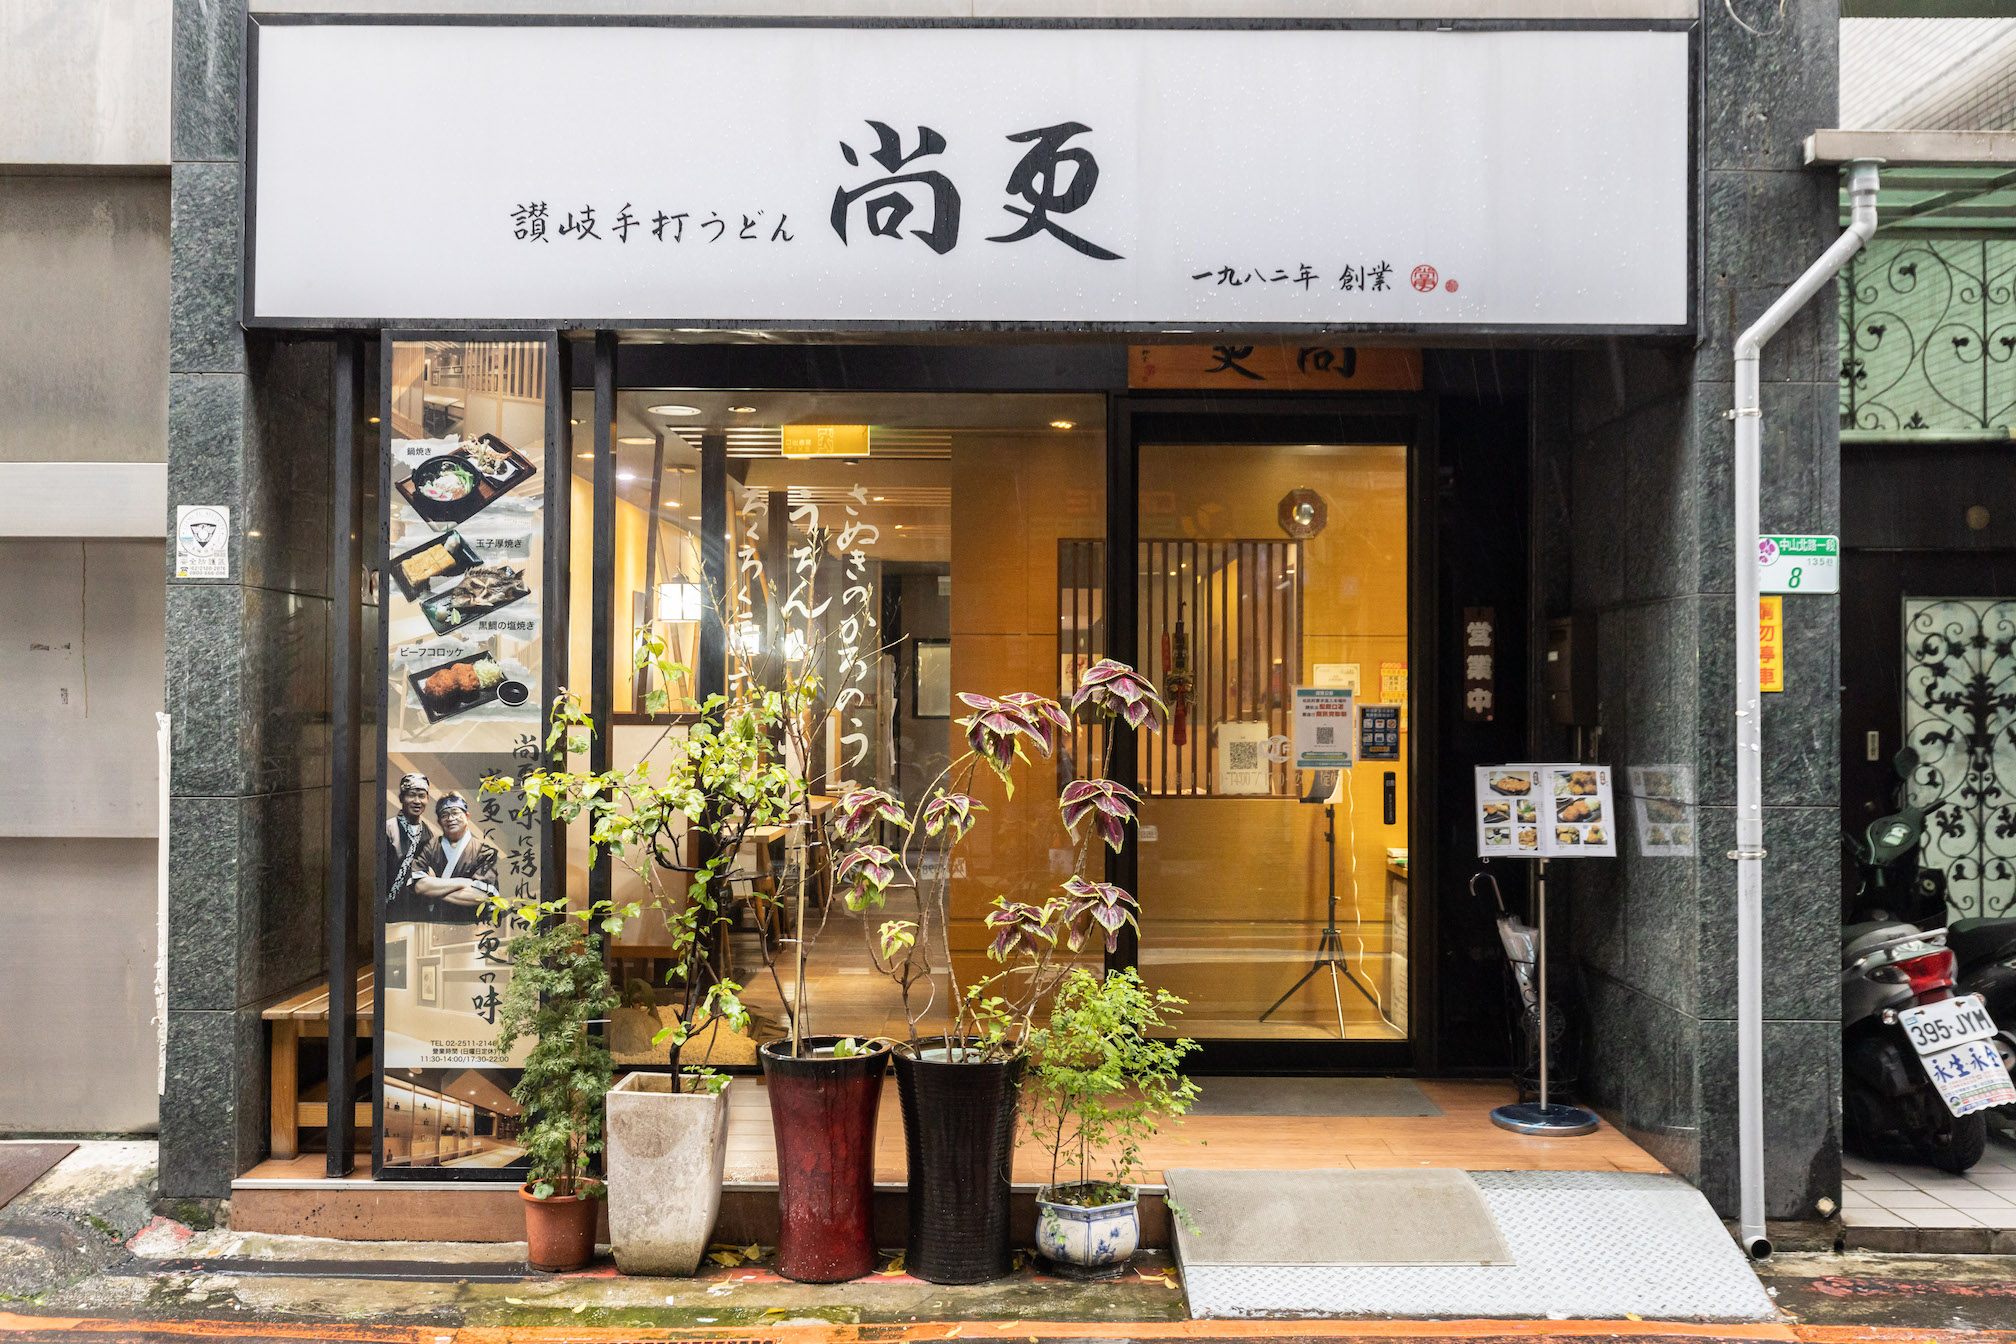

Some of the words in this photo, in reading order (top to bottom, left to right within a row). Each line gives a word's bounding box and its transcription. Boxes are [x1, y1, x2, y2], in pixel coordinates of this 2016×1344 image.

[830, 119, 1125, 261] 尚更
[1191, 264, 1319, 291] 一九八二年
[1339, 261, 1394, 292] 創業
[406, 447, 432, 456] 鍋焼き
[476, 538, 523, 549] 玉子厚焼き
[1778, 537, 1837, 553] 中山北路一段
[1788, 566, 1803, 589] 8
[400, 647, 465, 658] ビーフコロッケ
